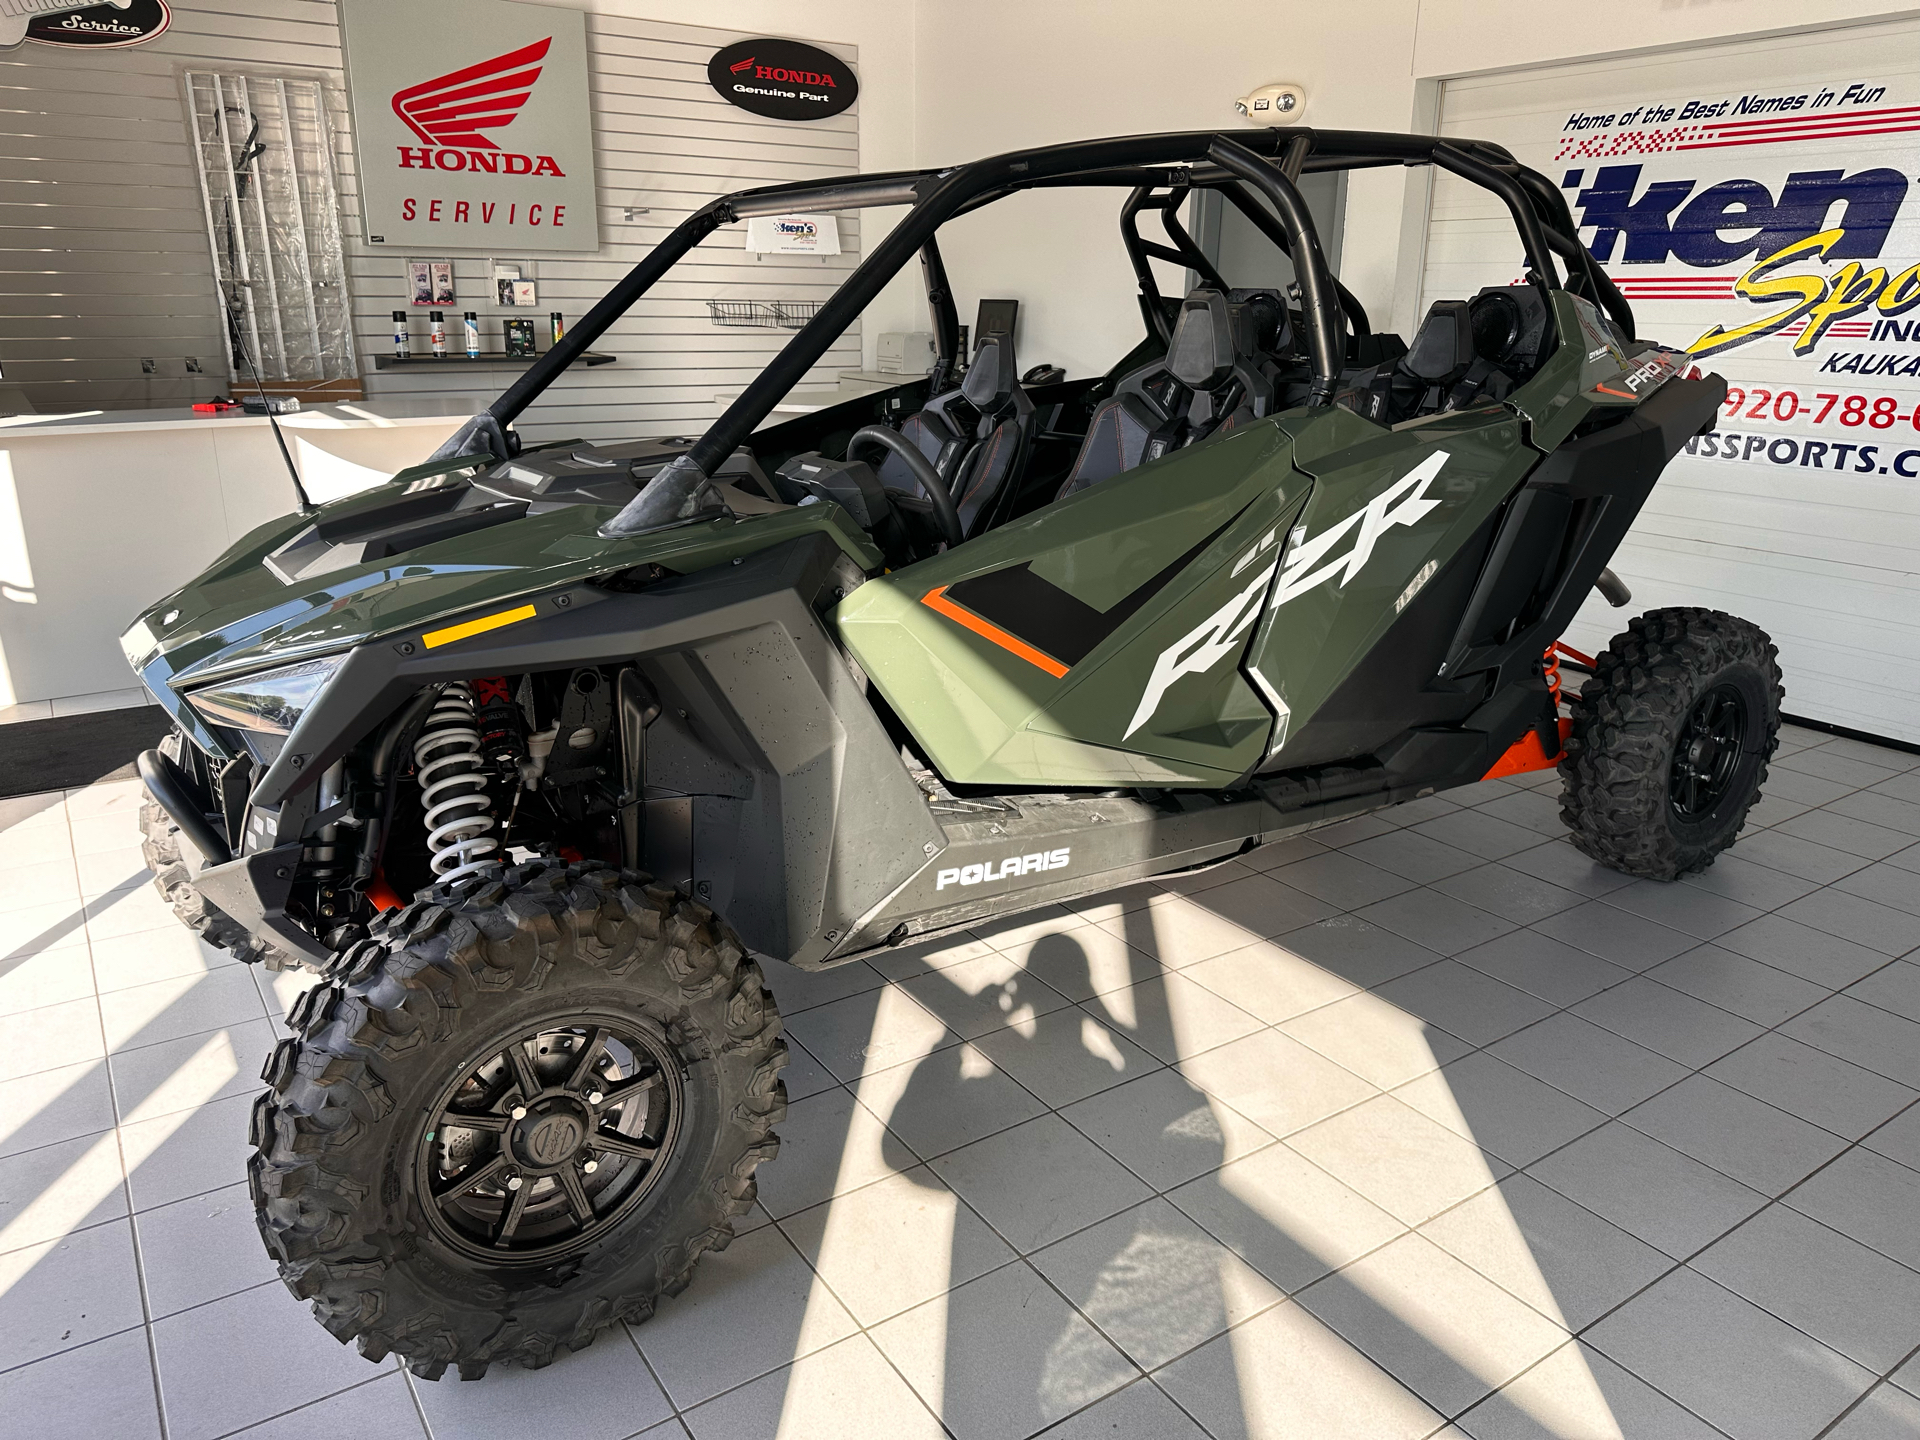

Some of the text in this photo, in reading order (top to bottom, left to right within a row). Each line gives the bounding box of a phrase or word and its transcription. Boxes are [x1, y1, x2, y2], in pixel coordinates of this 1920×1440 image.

[61, 14, 143, 35] Service
[755, 65, 837, 88] HONDA
[732, 84, 830, 102] Genuine Part
[1563, 83, 1887, 131] Home of the Best Names in Fun
[397, 146, 566, 177] HONDA
[402, 198, 566, 226] SERVICE
[1575, 163, 1920, 268] ken
[1821, 352, 1920, 377] KAUKA
[1724, 387, 1920, 432] 920-788-
[936, 847, 1071, 891] POLARIS
